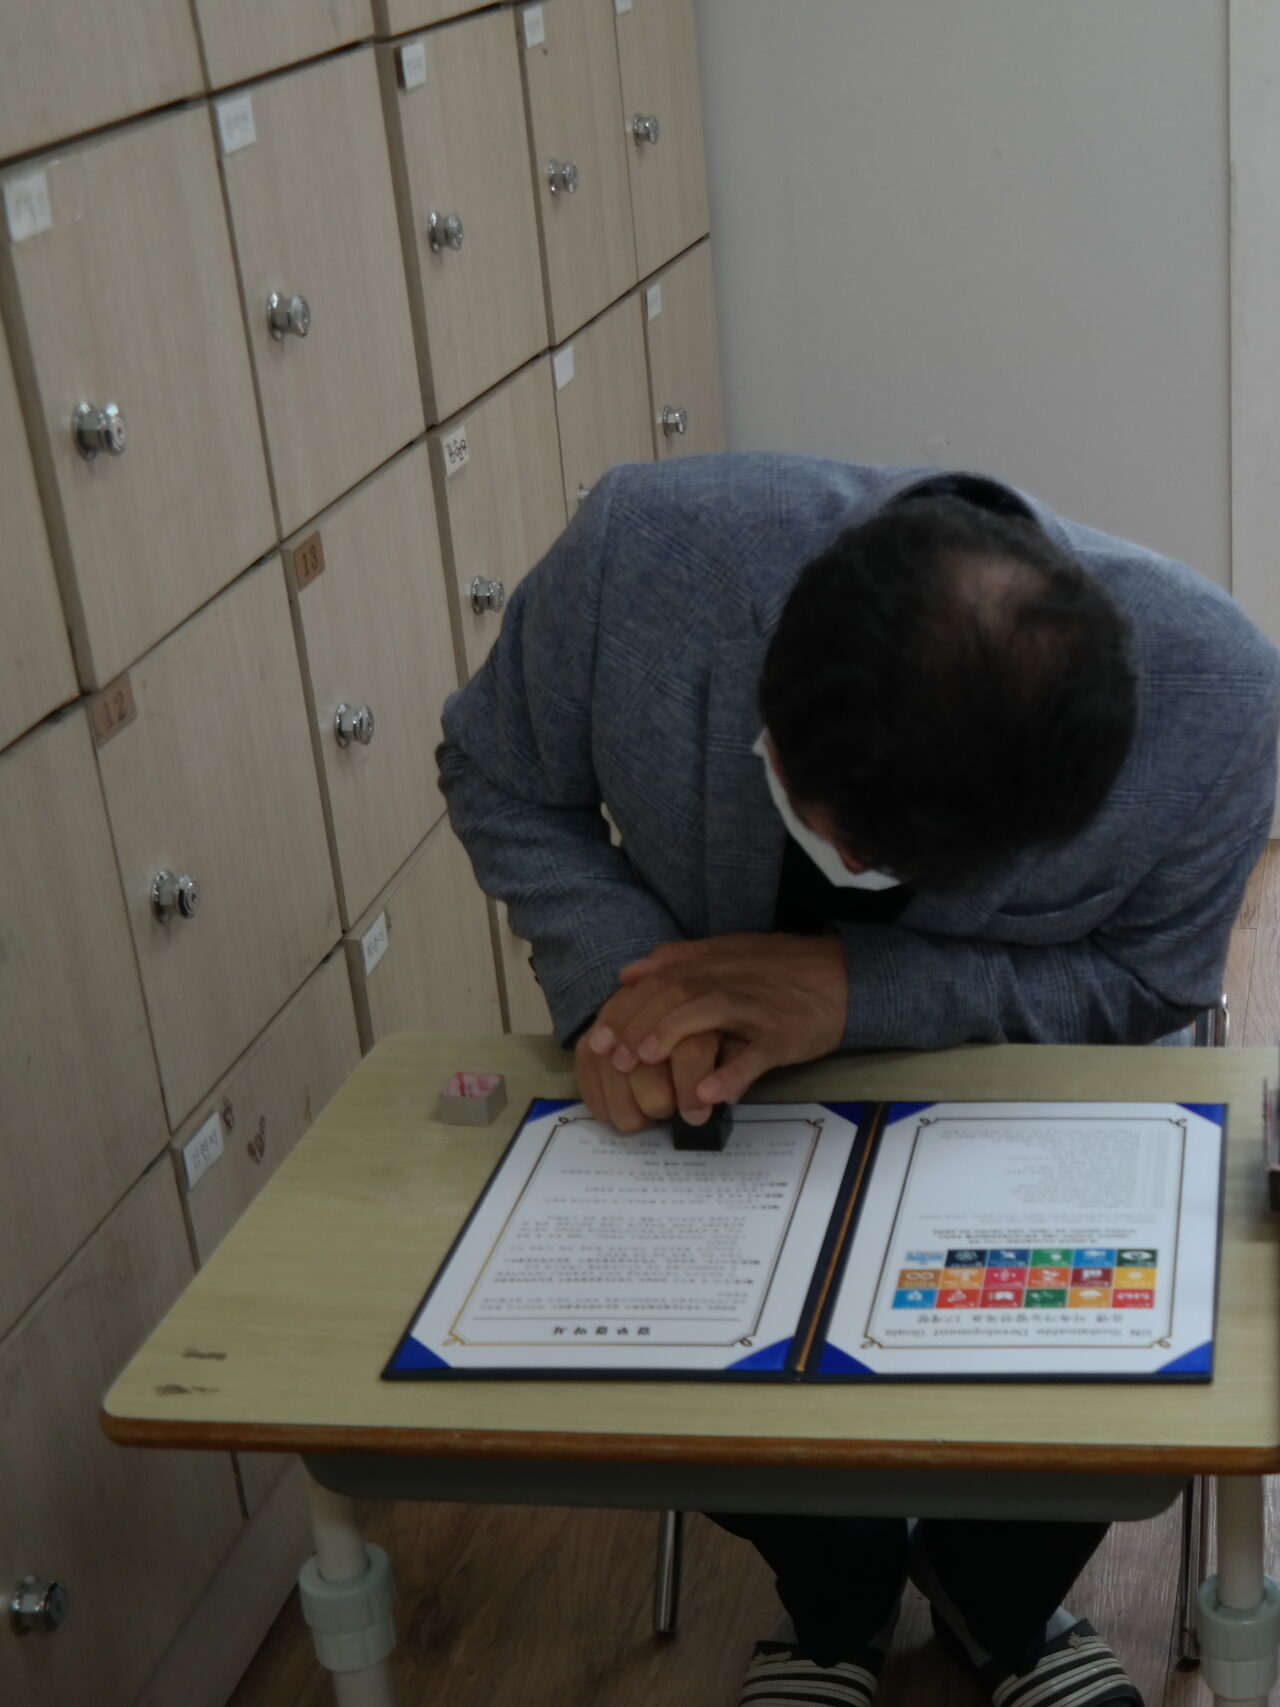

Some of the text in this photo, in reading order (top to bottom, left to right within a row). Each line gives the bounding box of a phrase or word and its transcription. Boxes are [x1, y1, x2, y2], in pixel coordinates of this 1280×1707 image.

[302, 545, 319, 578] 13
[103, 690, 128, 729] 12
[885, 1328, 926, 1338] Goals
[933, 1327, 1029, 1338] Development
[1037, 1327, 1122, 1337] Sustainable
